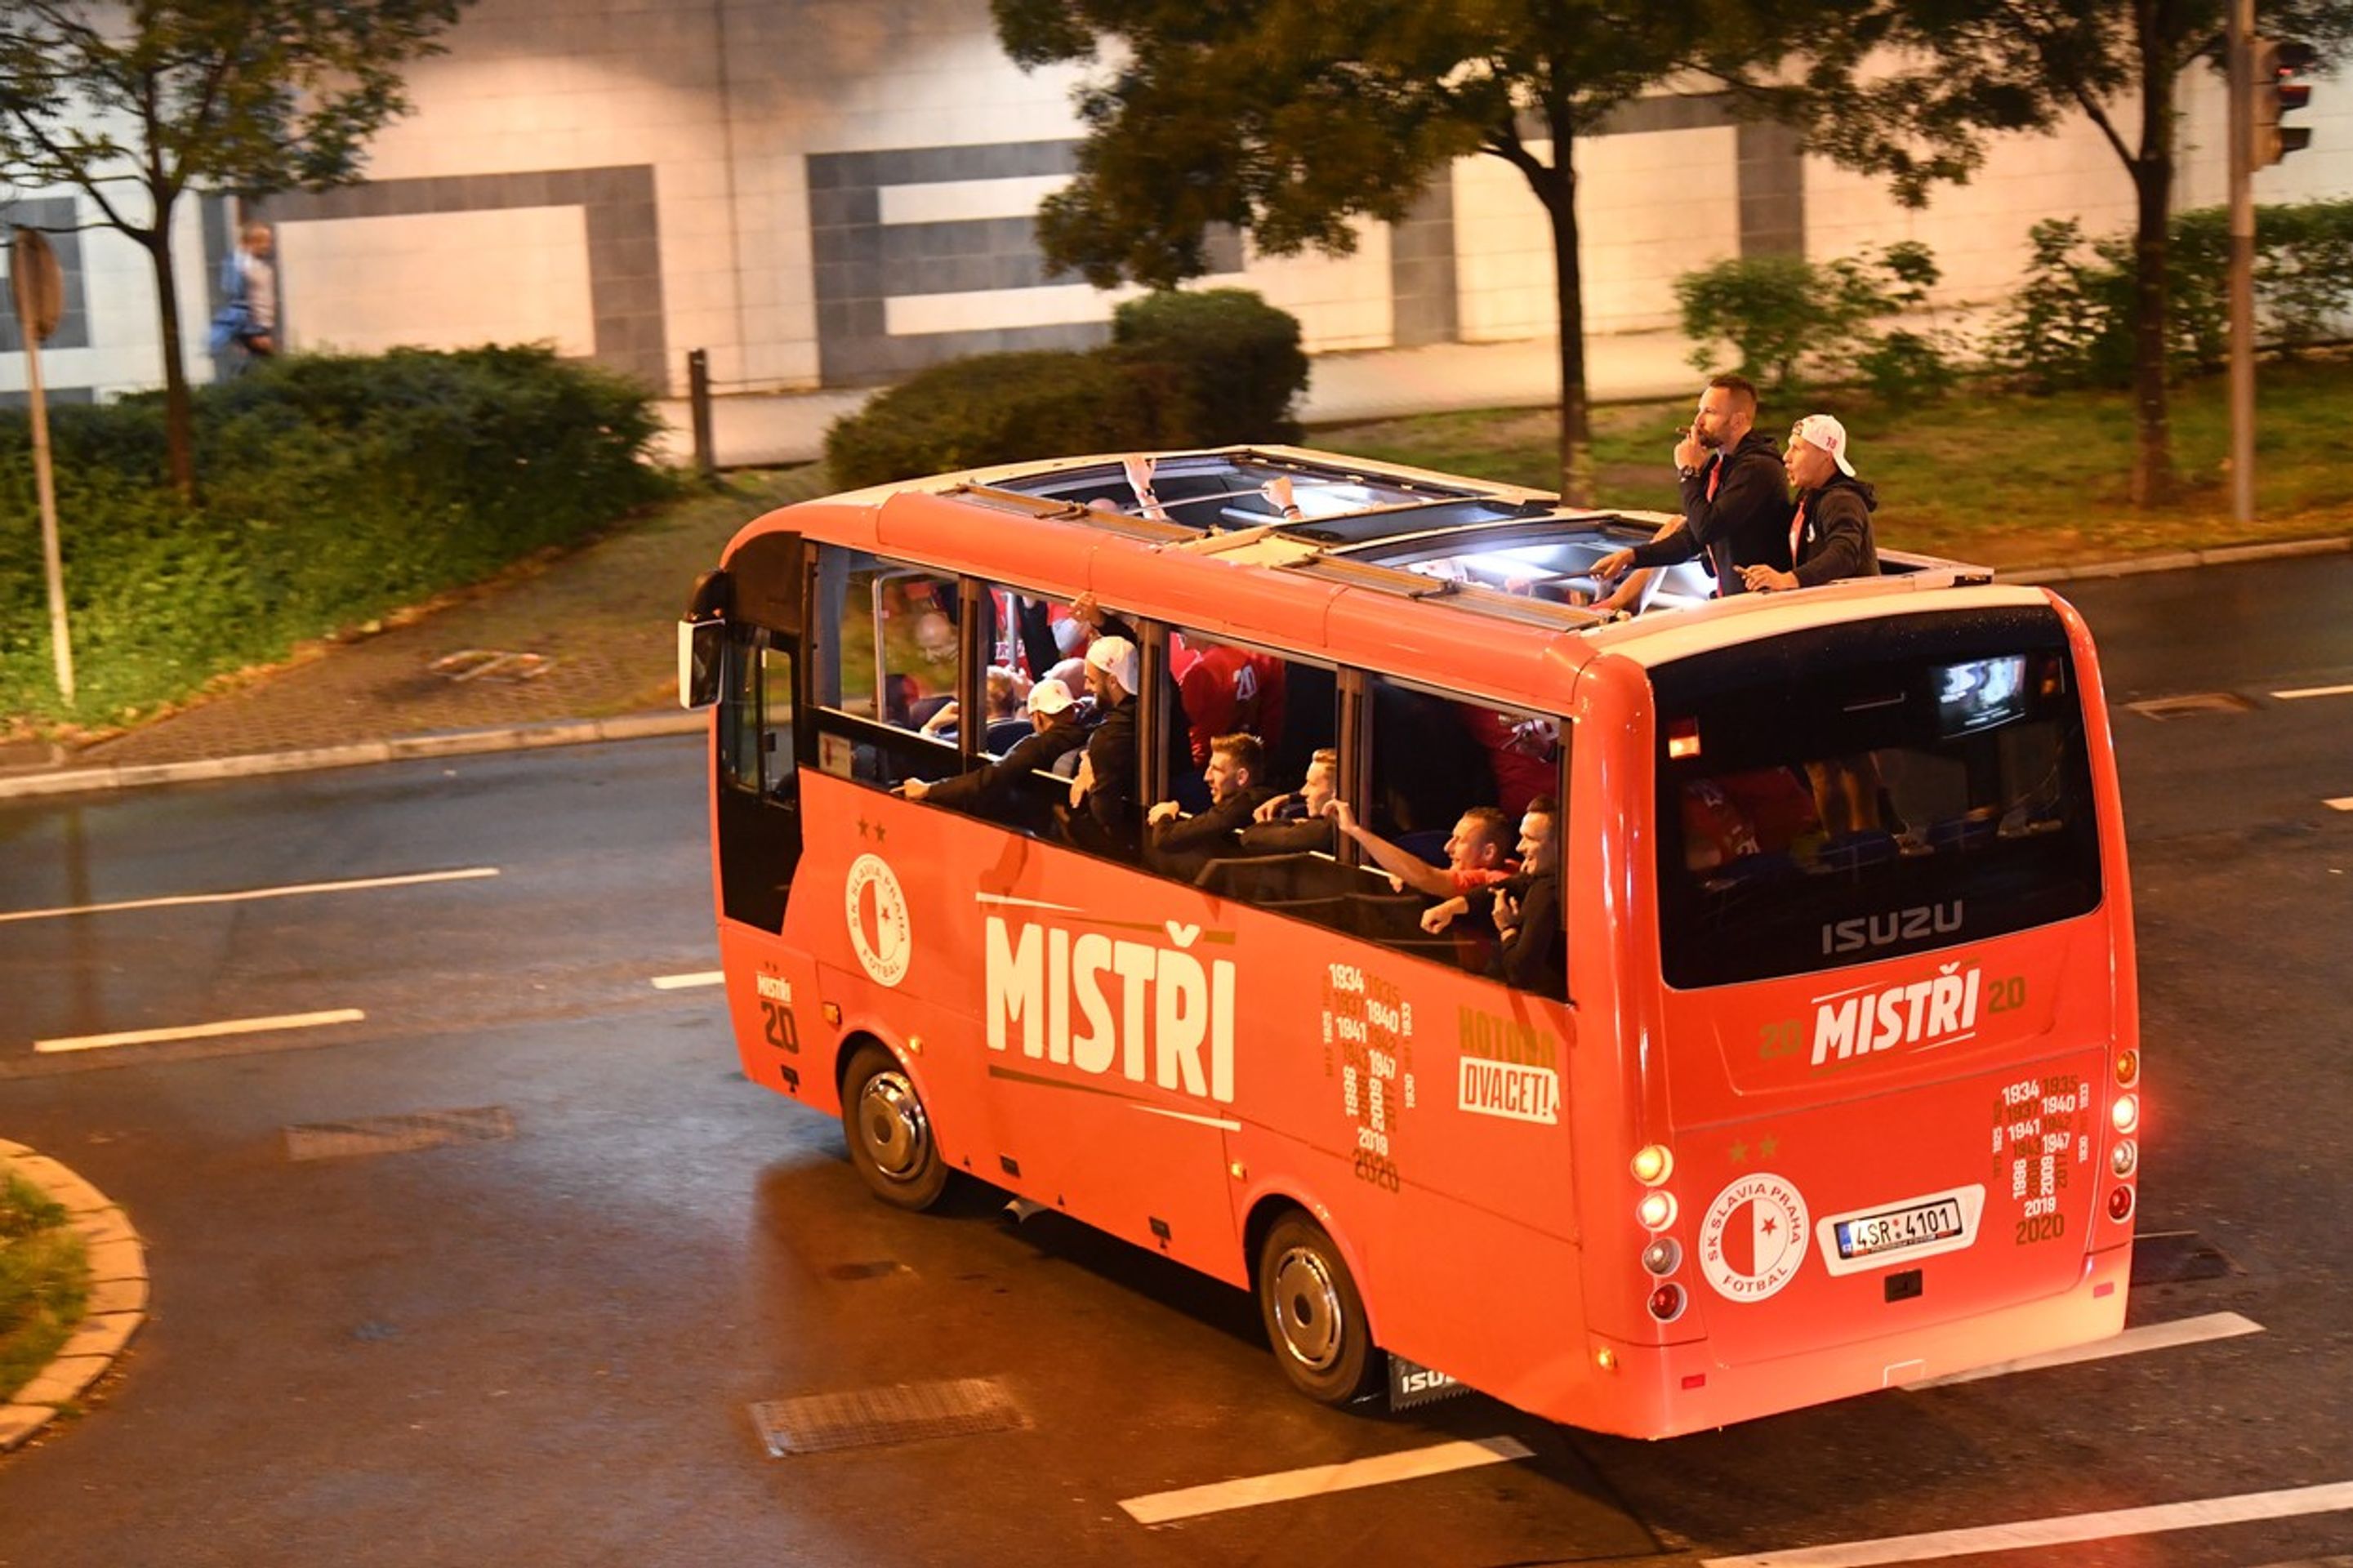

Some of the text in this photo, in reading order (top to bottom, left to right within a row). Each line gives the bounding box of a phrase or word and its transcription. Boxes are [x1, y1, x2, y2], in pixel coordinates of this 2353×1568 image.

[1232, 665, 1257, 701] 20
[1822, 899, 1963, 955] ISUZU
[1328, 964, 1365, 994] 1934
[760, 1000, 800, 1054] 20
[986, 915, 1236, 1103] MISTŘI
[1366, 998, 1399, 1034] 1940
[1758, 961, 2025, 1066] 20 MISTŘI 20
[1335, 1016, 1367, 1044] 1941
[1369, 1049, 1396, 1080] 1947
[1464, 1063, 1550, 1117] DVACET!
[2002, 1080, 2040, 1106] 1934
[2043, 1075, 2079, 1096] 1935
[1368, 1076, 1385, 1132] 2009
[2006, 1101, 2039, 1122] 1937
[2041, 1094, 2076, 1115] 1940
[2007, 1118, 2040, 1142] 1941
[2042, 1133, 2070, 1154] 1947
[1353, 1147, 1400, 1193] 2020
[2040, 1154, 2055, 1197] 2009
[2056, 1152, 2068, 1189] 2017
[1711, 1183, 1767, 1230] SLAVIA
[1770, 1186, 1802, 1245] PRAHA
[1856, 1221, 1892, 1248] 4SR
[1905, 1206, 1950, 1237] 4101
[2015, 1214, 2065, 1246] 2020
[1707, 1236, 1718, 1262] SK
[1722, 1267, 1788, 1293] FOTBAL
